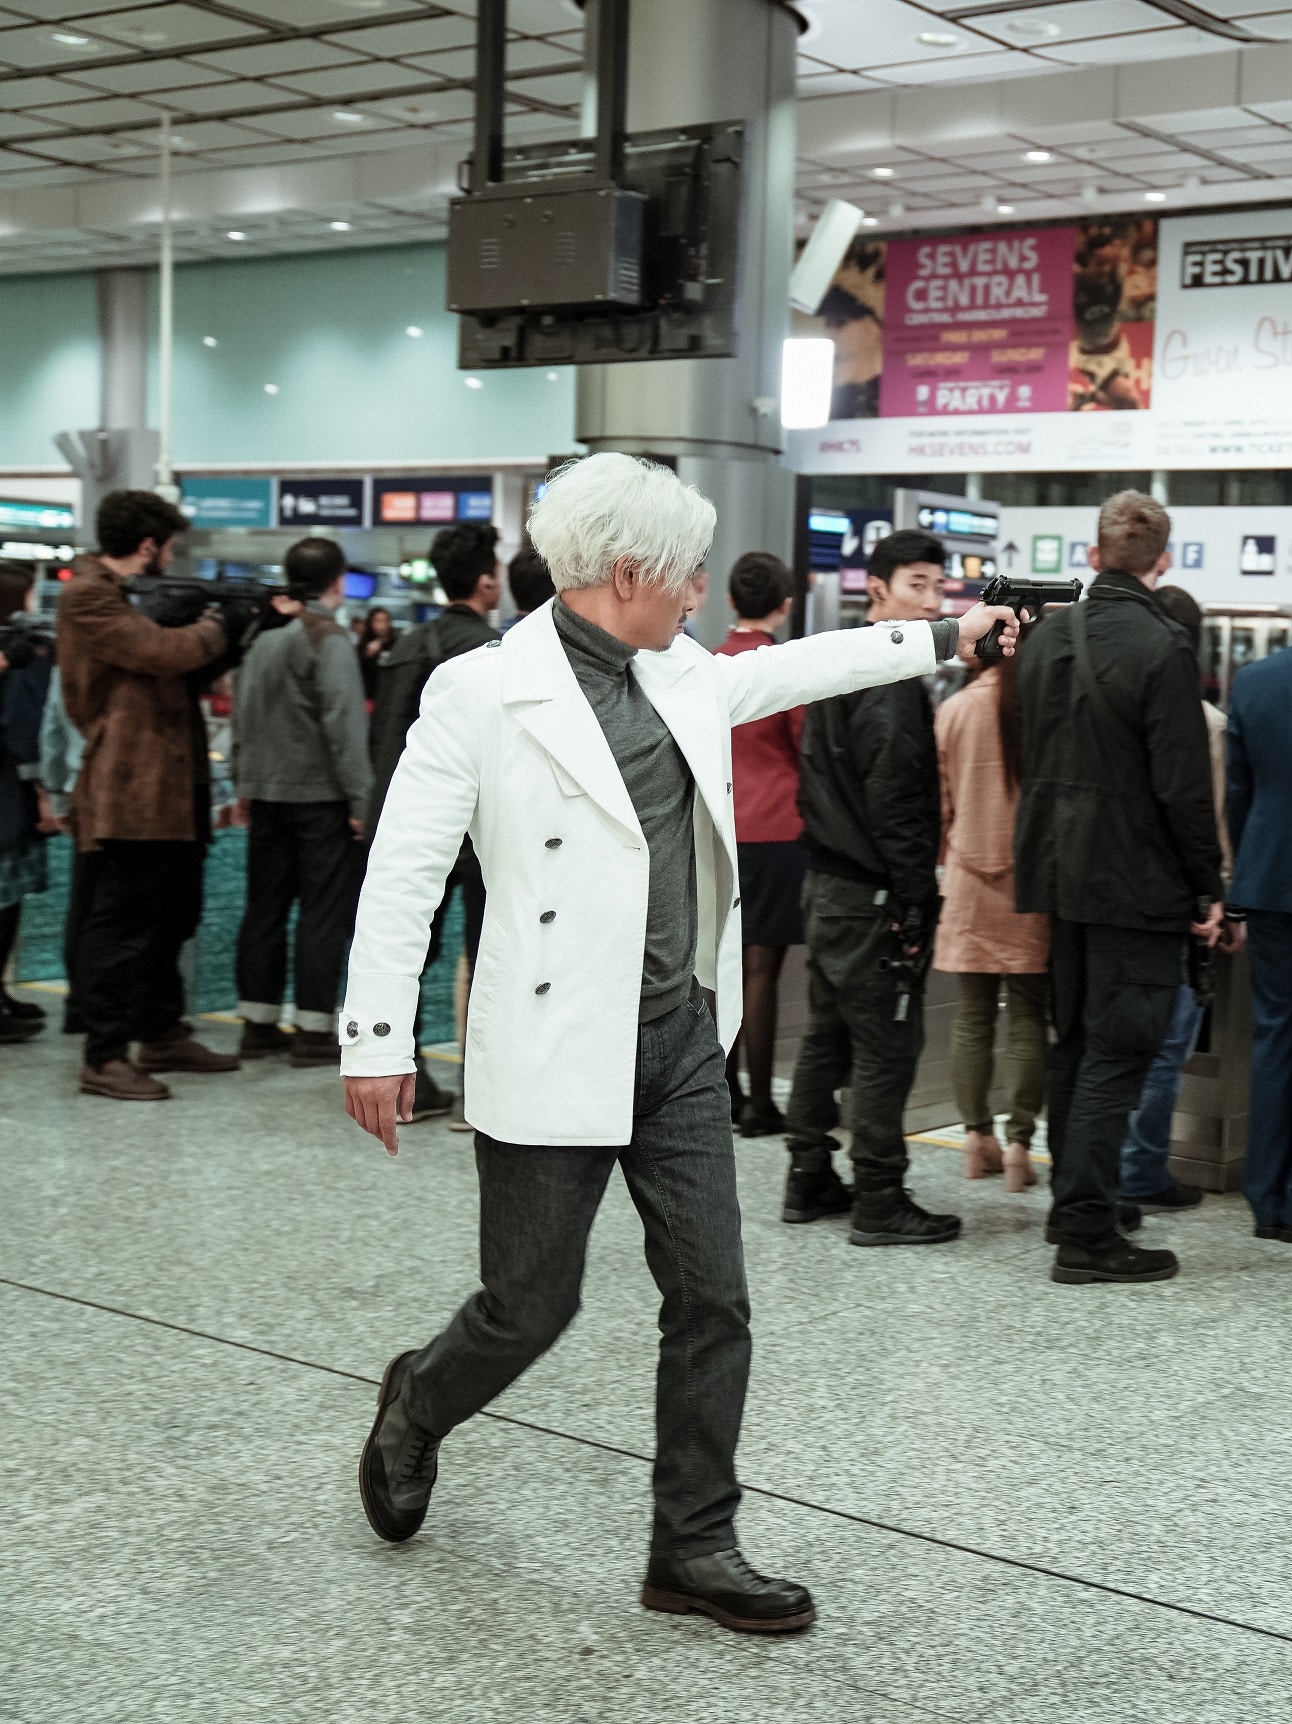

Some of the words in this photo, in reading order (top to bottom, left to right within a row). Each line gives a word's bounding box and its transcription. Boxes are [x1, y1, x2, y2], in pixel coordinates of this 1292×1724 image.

[917, 237, 1038, 276] SEVENS
[906, 272, 1048, 310] CENTRAL
[935, 386, 1011, 412] PARTY
[907, 439, 1032, 458] HKSEVENS.COM
[1187, 545, 1200, 564] F
